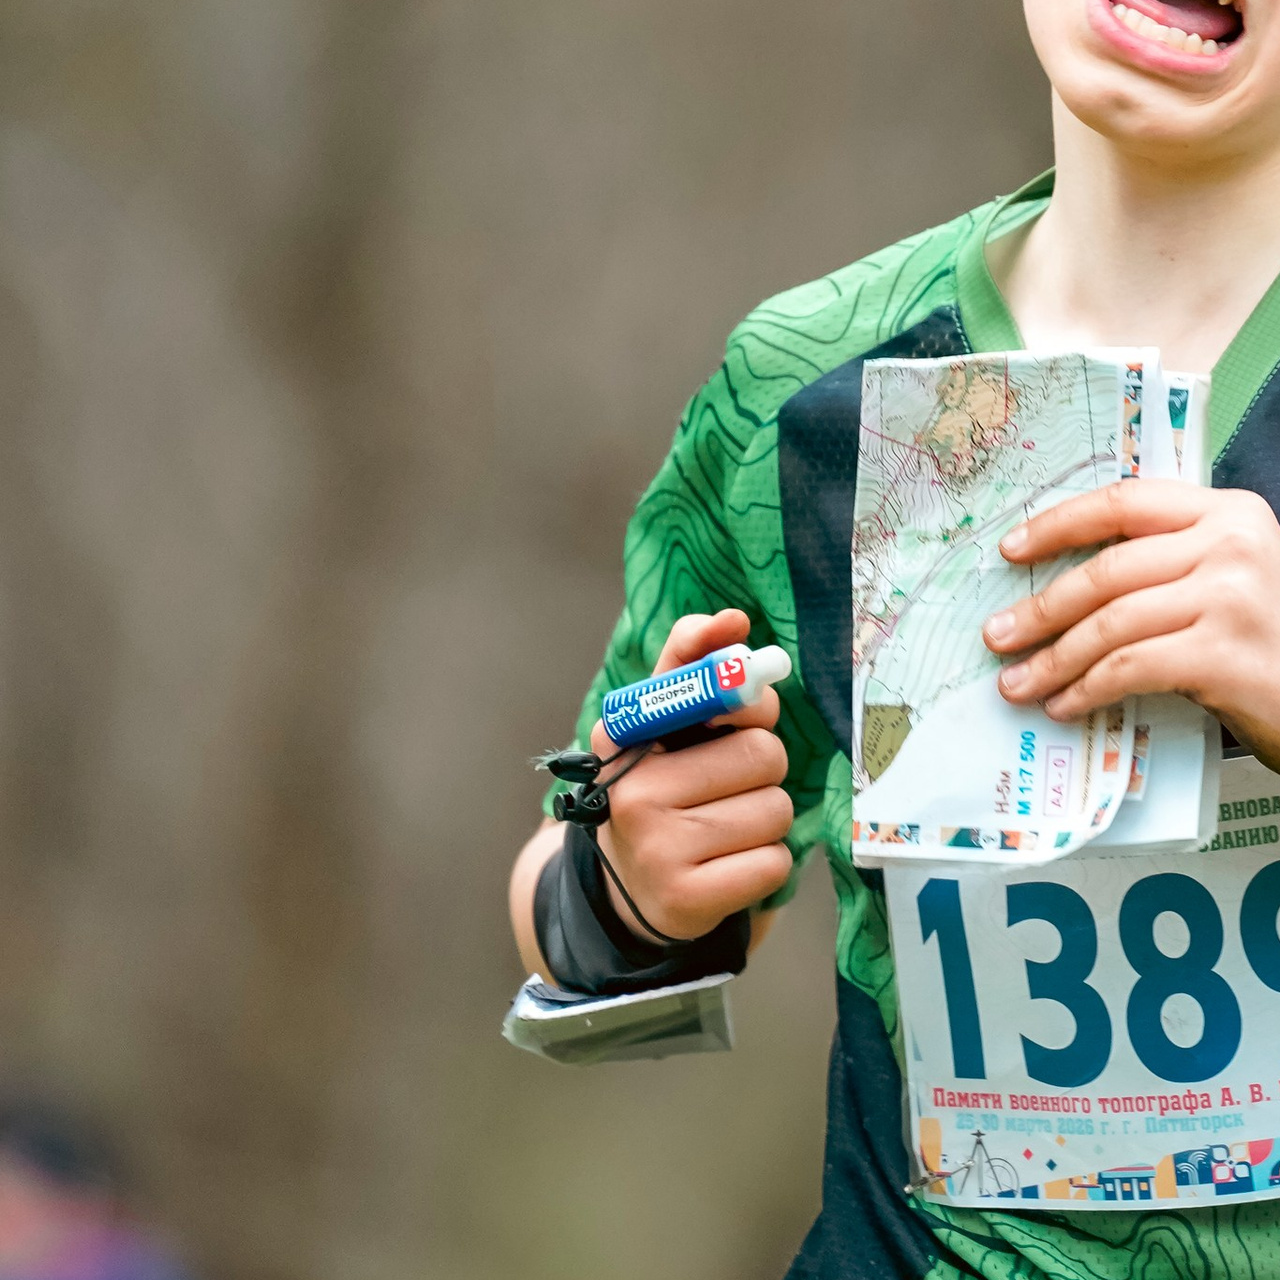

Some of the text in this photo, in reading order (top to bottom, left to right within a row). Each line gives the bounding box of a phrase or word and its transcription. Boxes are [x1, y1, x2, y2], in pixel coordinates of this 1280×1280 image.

[644, 683, 695, 707] 8540501
[1020, 730, 1036, 762] 500
[1200, 825, 1279, 852] ВАНИЮ
[933, 1087, 1003, 1109] Памяти
[1008, 1093, 1091, 1113] военного
[1098, 1089, 1212, 1116] топографа
[1220, 1087, 1241, 1107] А.
[1249, 1083, 1271, 1103] В.
[1005, 1117, 1051, 1136] марта
[1057, 1117, 1095, 1135] 2026
[1145, 1112, 1244, 1134] Пятигорск
